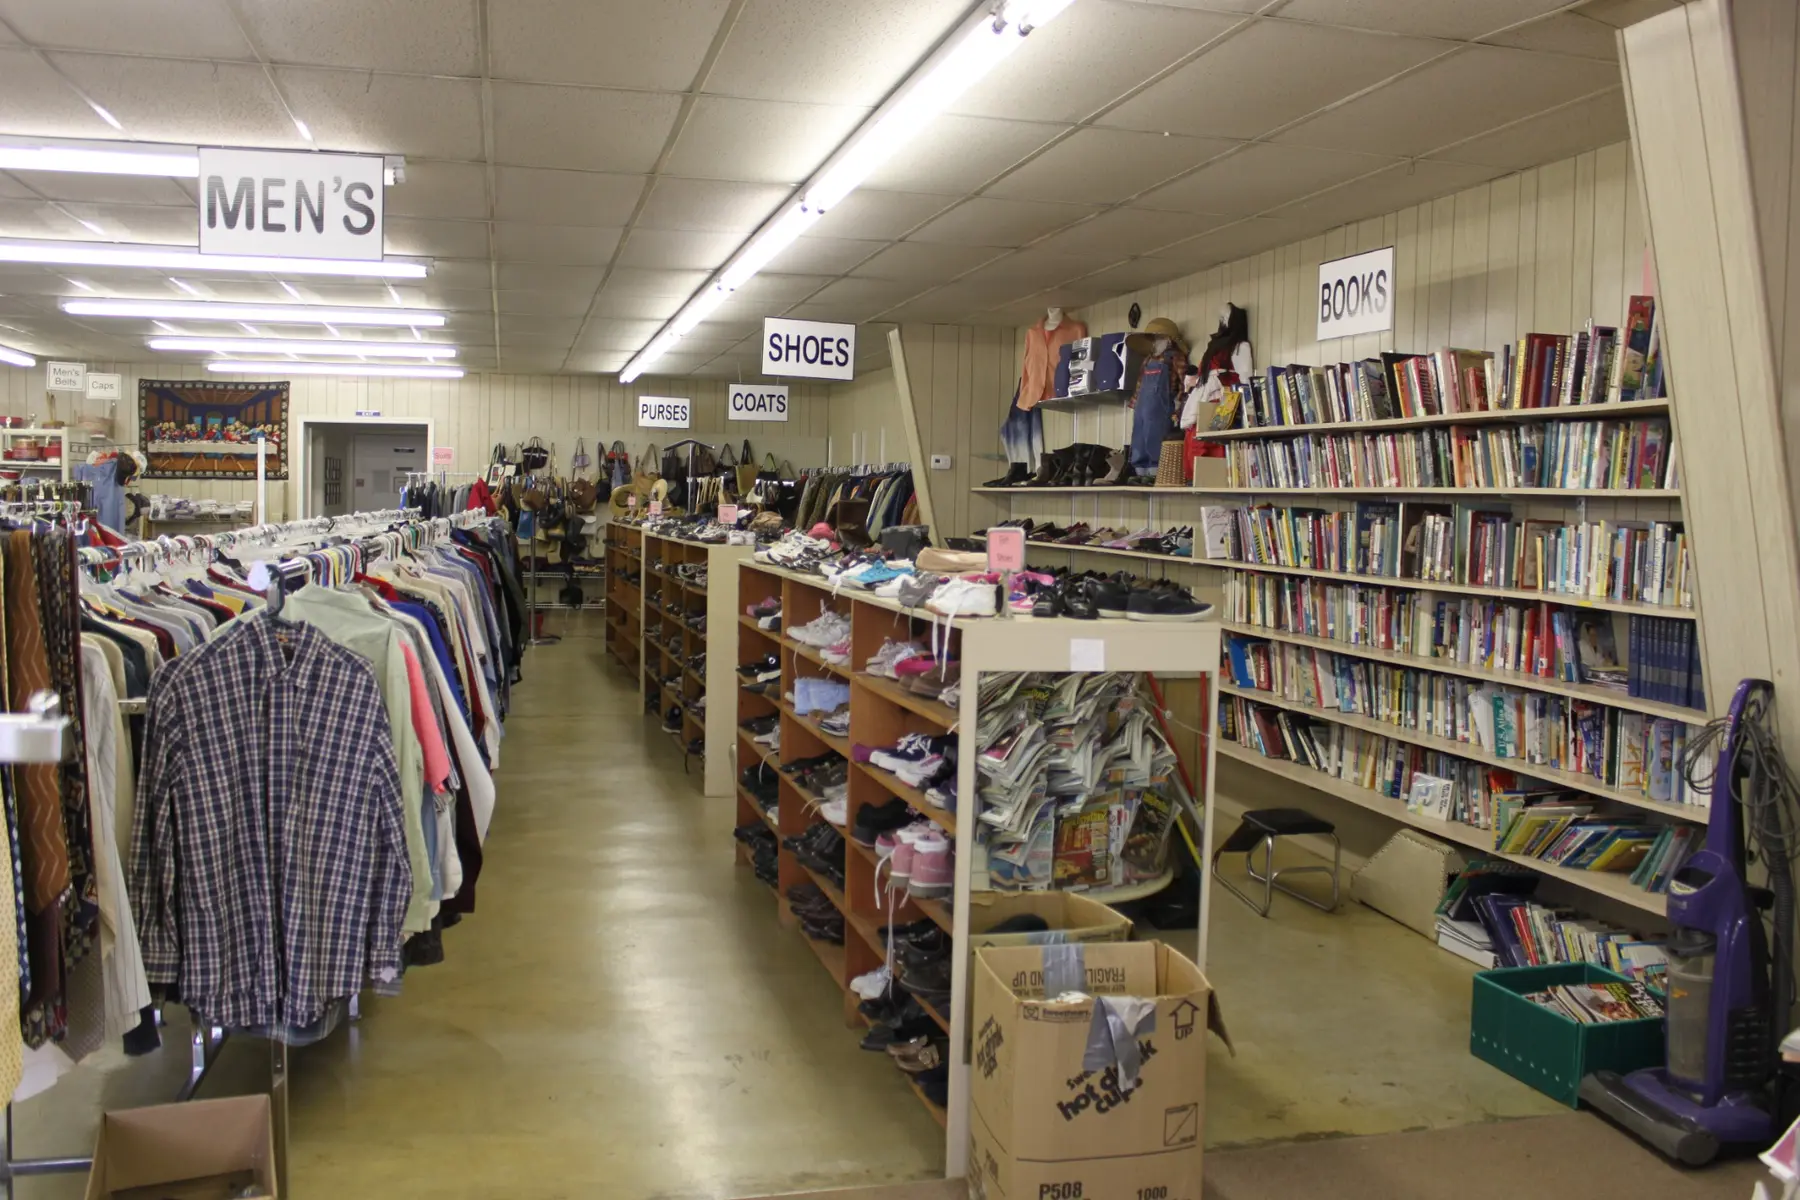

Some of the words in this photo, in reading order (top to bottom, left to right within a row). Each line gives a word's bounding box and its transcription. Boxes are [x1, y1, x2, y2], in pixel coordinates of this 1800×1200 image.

[206, 175, 375, 236] MEN'S
[1321, 269, 1387, 323] BOOKS
[768, 332, 850, 368] SHOES
[53, 367, 80, 377] Men's
[55, 377, 77, 387] Belts
[91, 380, 115, 391] Caps
[731, 391, 787, 414] COATS
[640, 403, 688, 423] PURSES
[1012, 970, 1027, 988] UP
[1086, 967, 1126, 984] FRAGIL
[1174, 1028, 1194, 1041] UP
[1056, 1082, 1100, 1122] hot
[1039, 1181, 1083, 1200] P508
[1136, 1186, 1168, 1200] 1000
